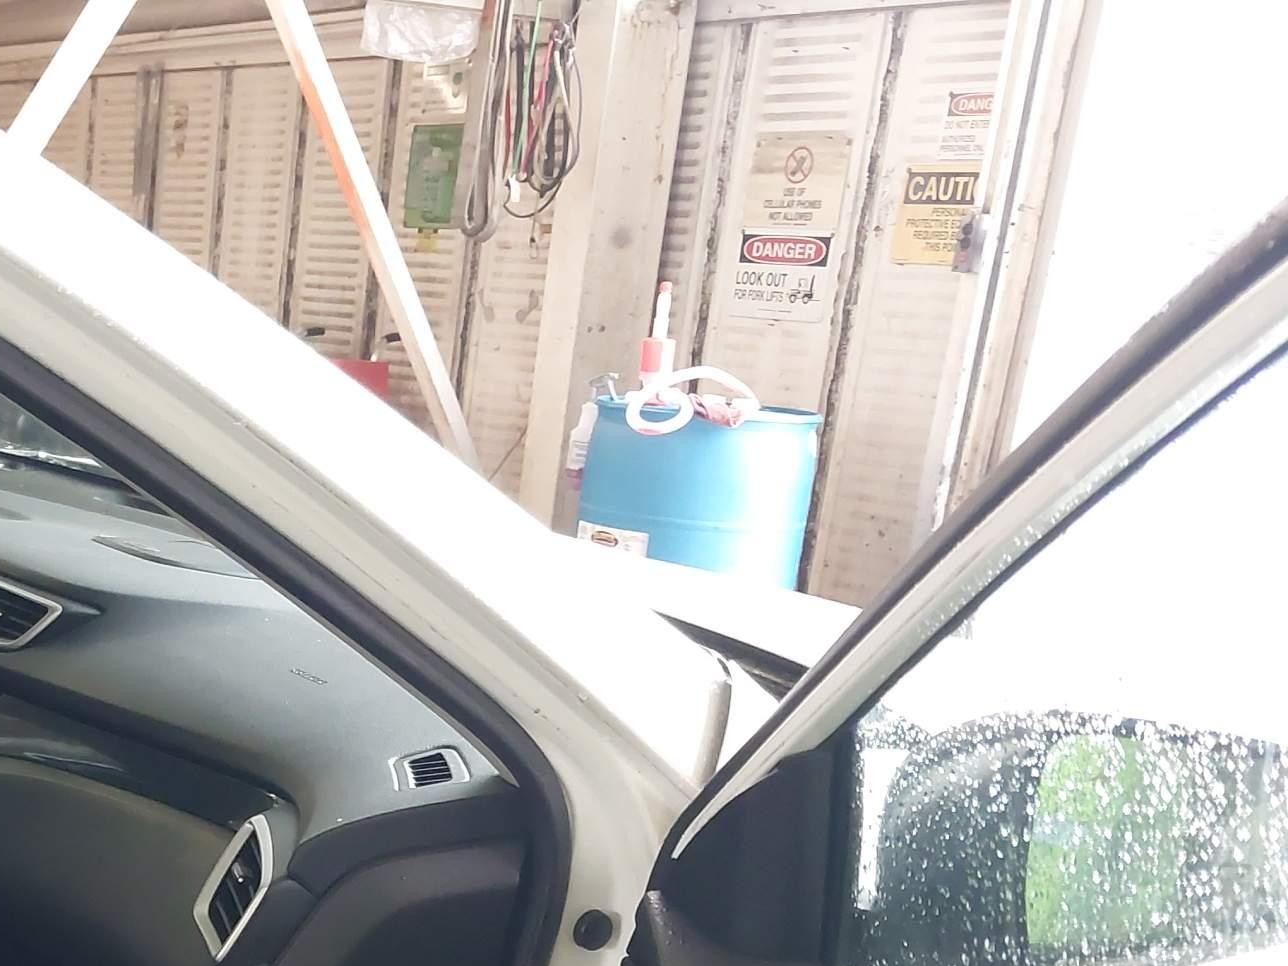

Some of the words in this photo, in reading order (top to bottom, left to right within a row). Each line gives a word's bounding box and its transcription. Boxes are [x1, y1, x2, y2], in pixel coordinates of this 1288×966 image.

[752, 241, 817, 260] DANGER
[736, 271, 765, 286] LOOK
[766, 272, 789, 288] OUT
